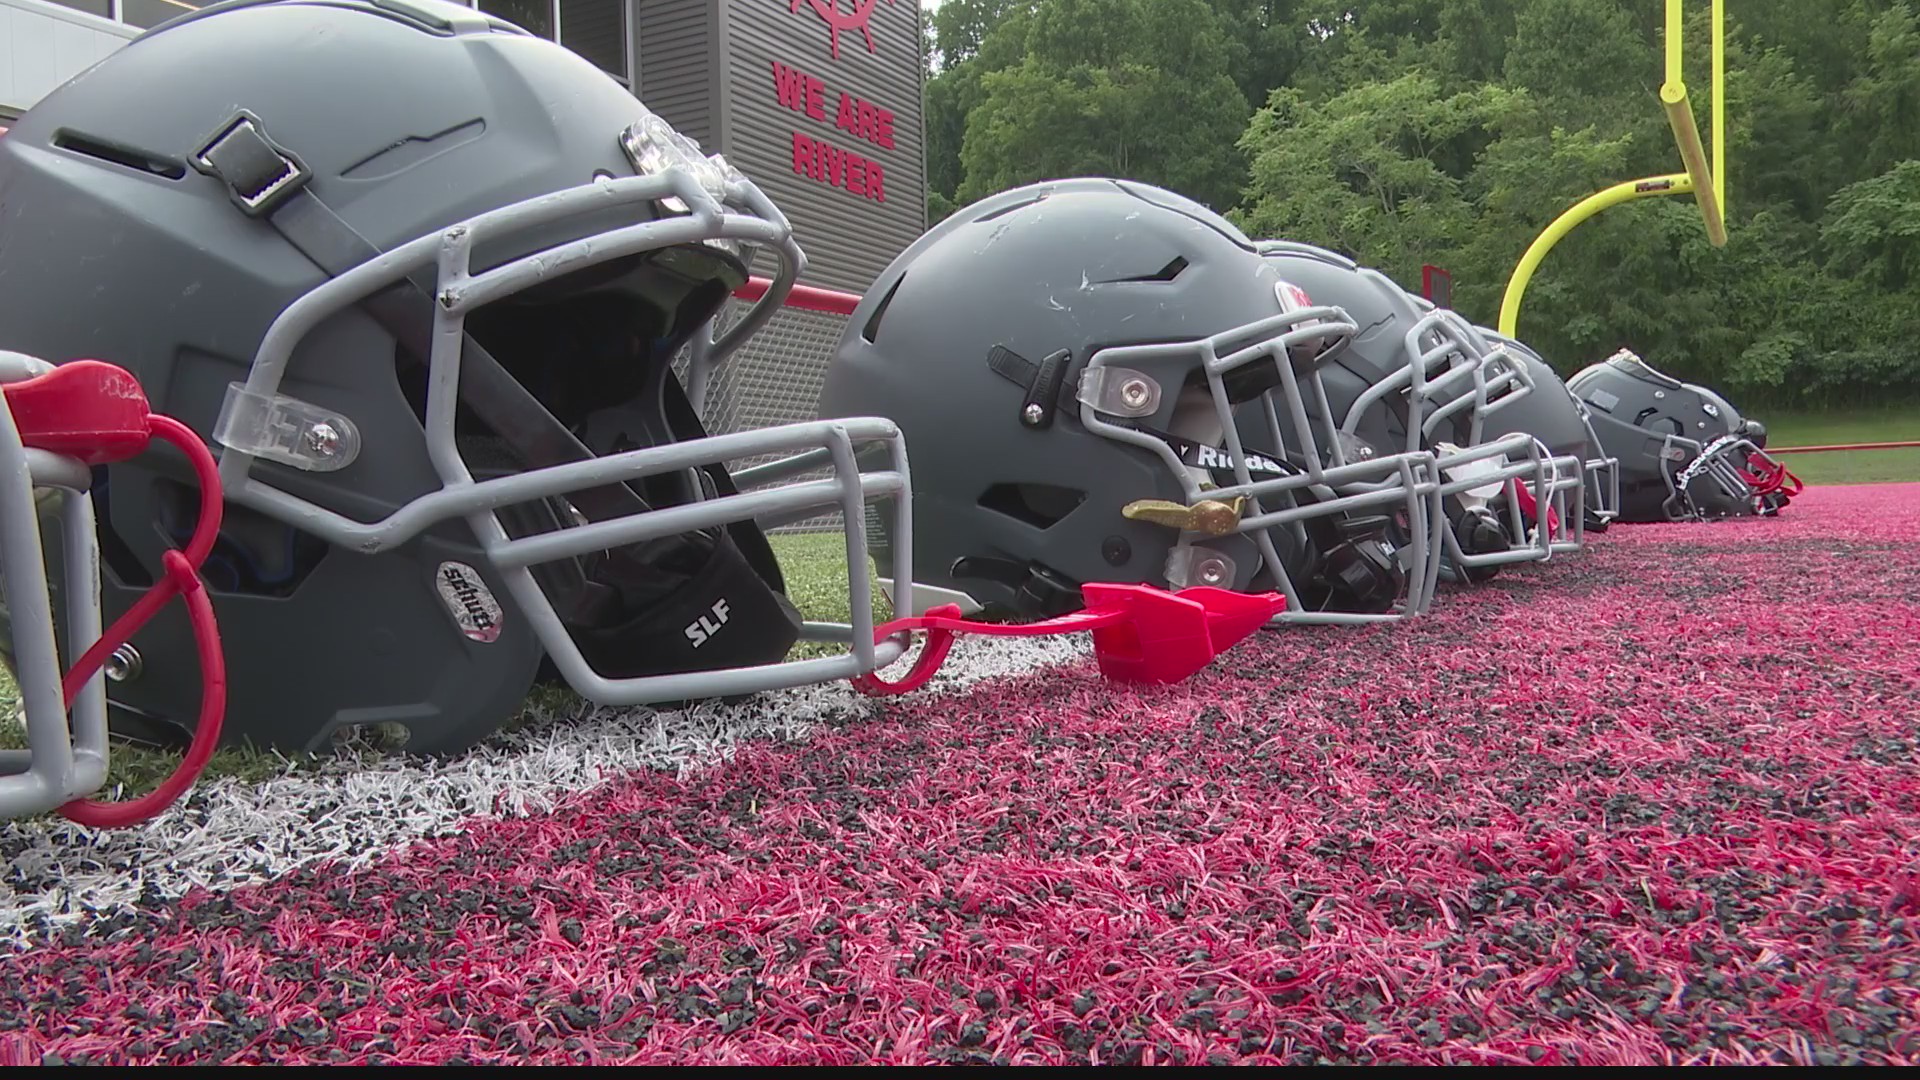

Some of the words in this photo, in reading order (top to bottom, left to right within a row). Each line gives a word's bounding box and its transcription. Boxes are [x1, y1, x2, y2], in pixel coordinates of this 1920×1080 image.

[771, 61, 825, 121] WE
[836, 91, 896, 150] ARE
[792, 131, 885, 202] RIVER
[443, 568, 495, 630] schutt
[684, 597, 731, 648] SLF
